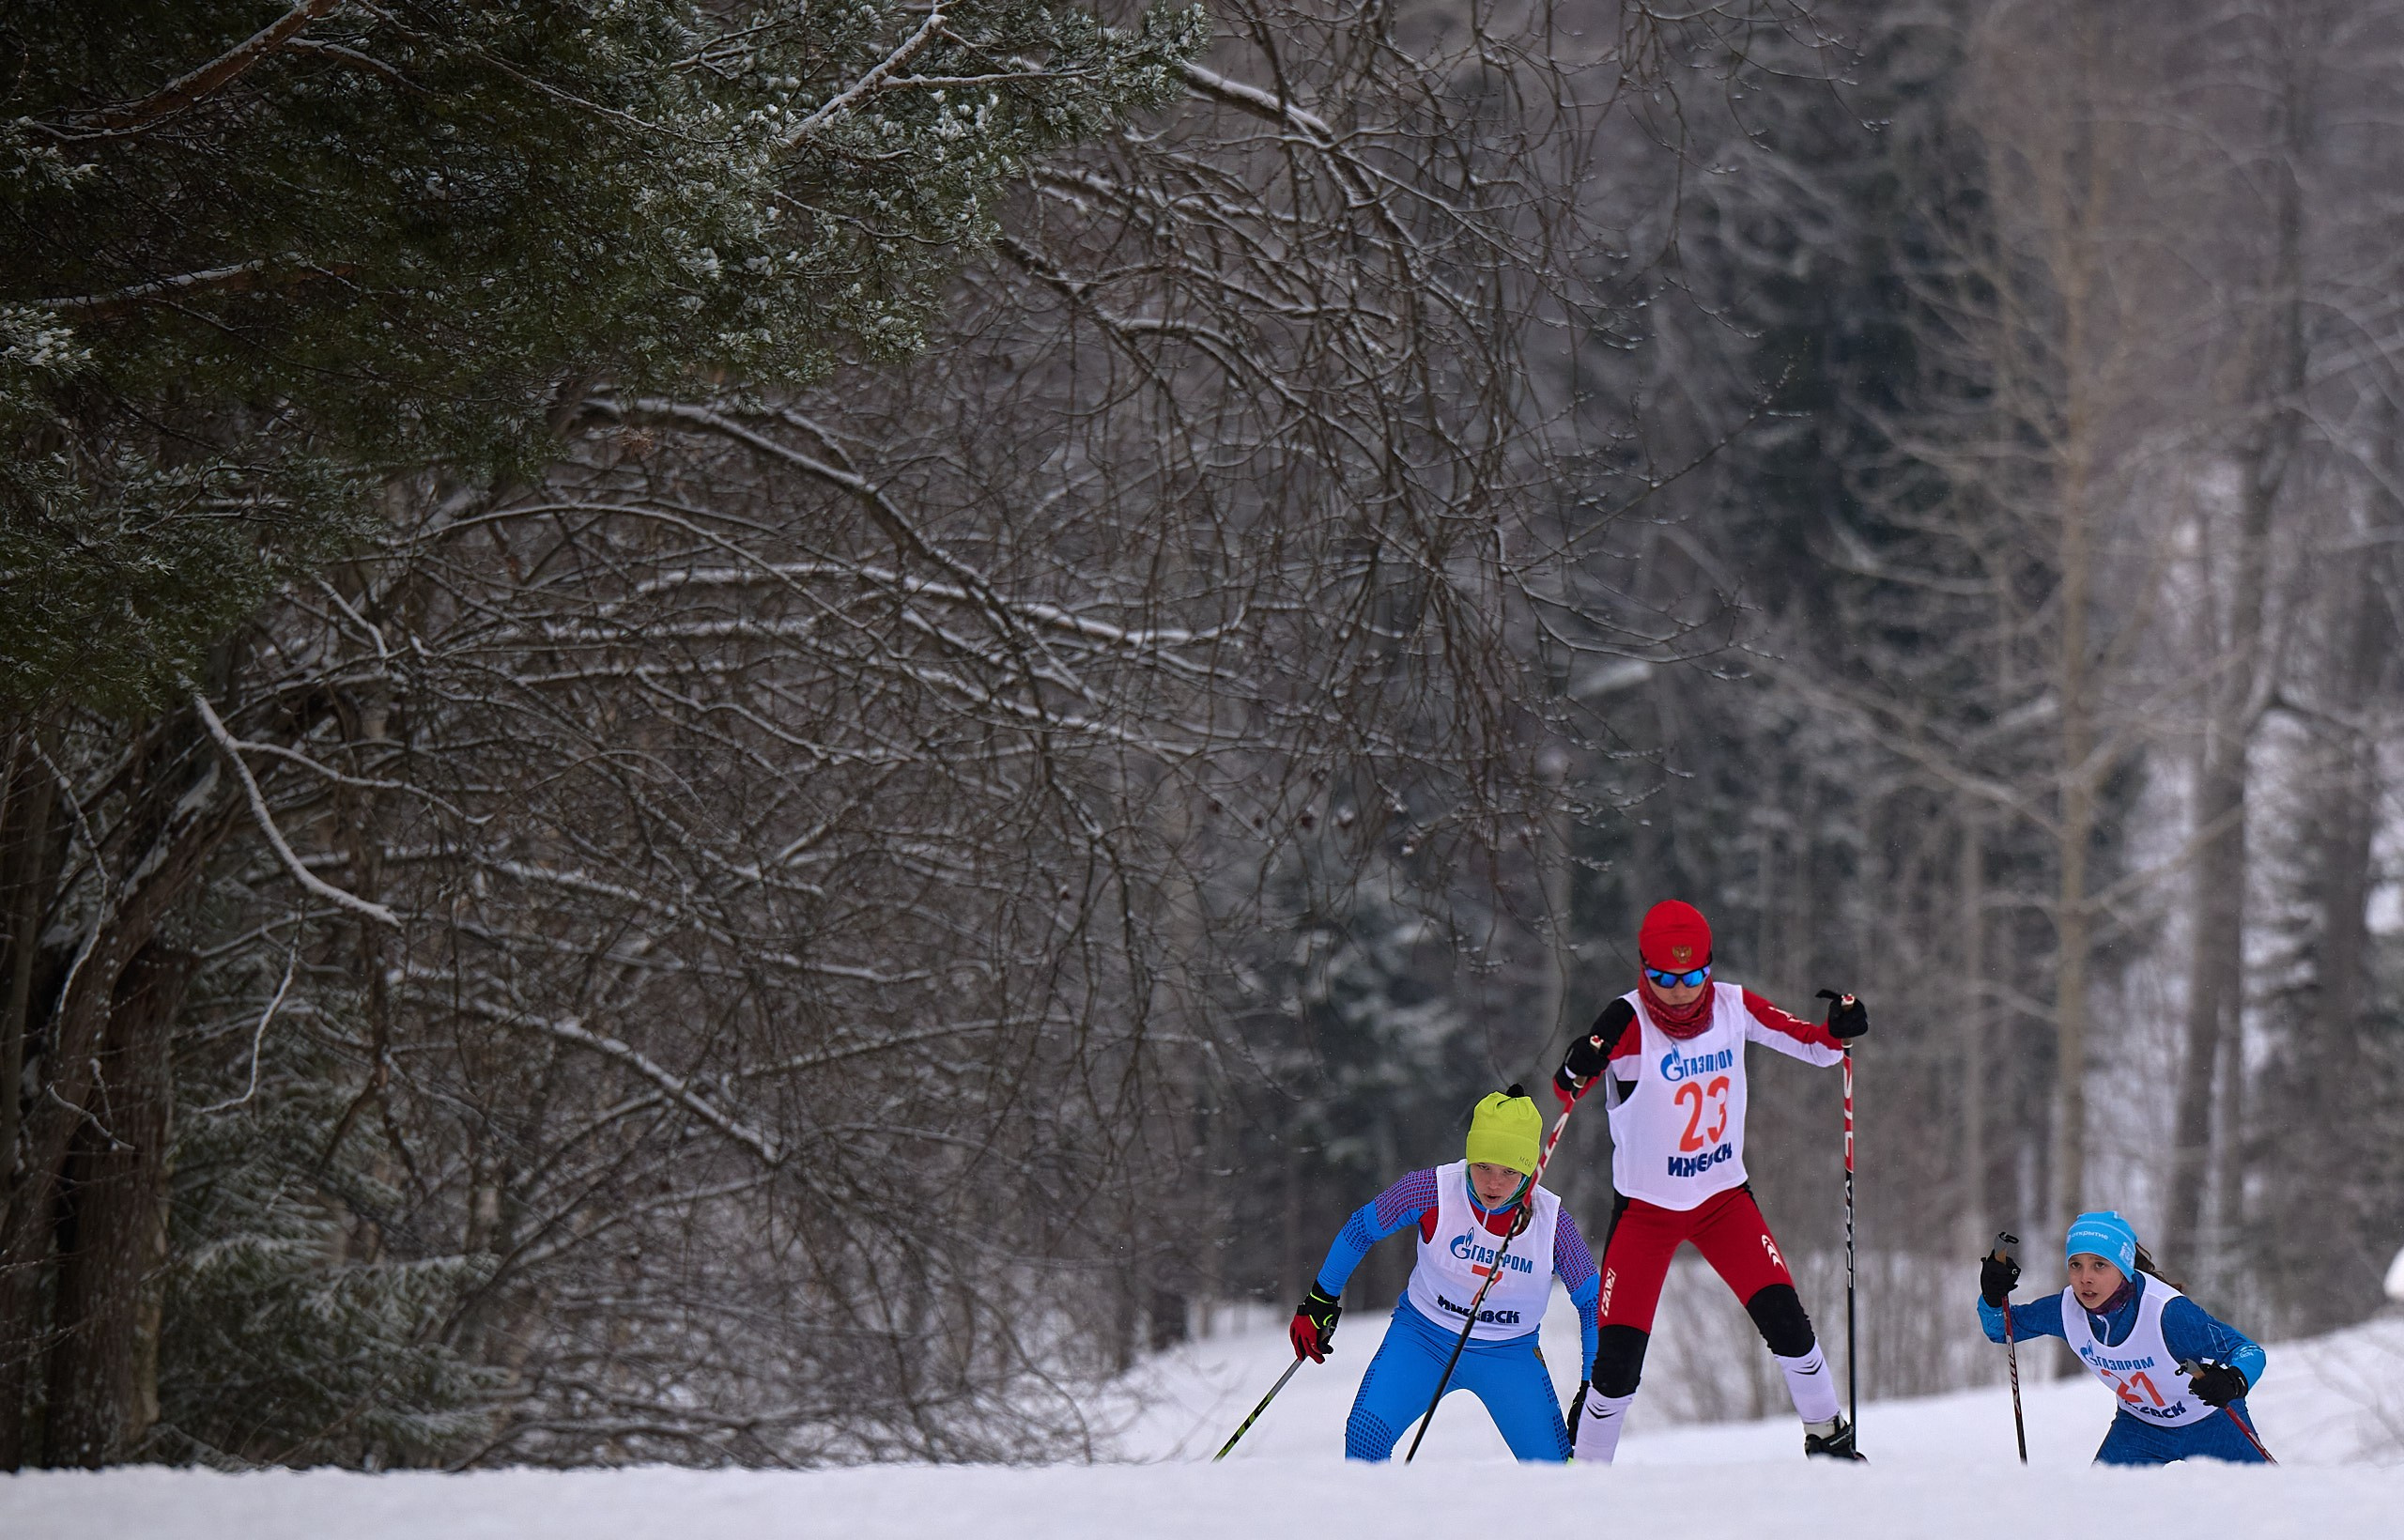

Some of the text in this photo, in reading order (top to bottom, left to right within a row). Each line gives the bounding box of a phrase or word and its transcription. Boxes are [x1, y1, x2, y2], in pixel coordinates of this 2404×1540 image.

[1674, 1076, 1730, 1152] 23
[1471, 1245, 1533, 1273] ГАЗРОМ
[1471, 1264, 1503, 1305] 7
[1438, 1295, 1520, 1324] ИЖВСК
[2096, 1356, 2154, 1370] ГАЗПРОМ
